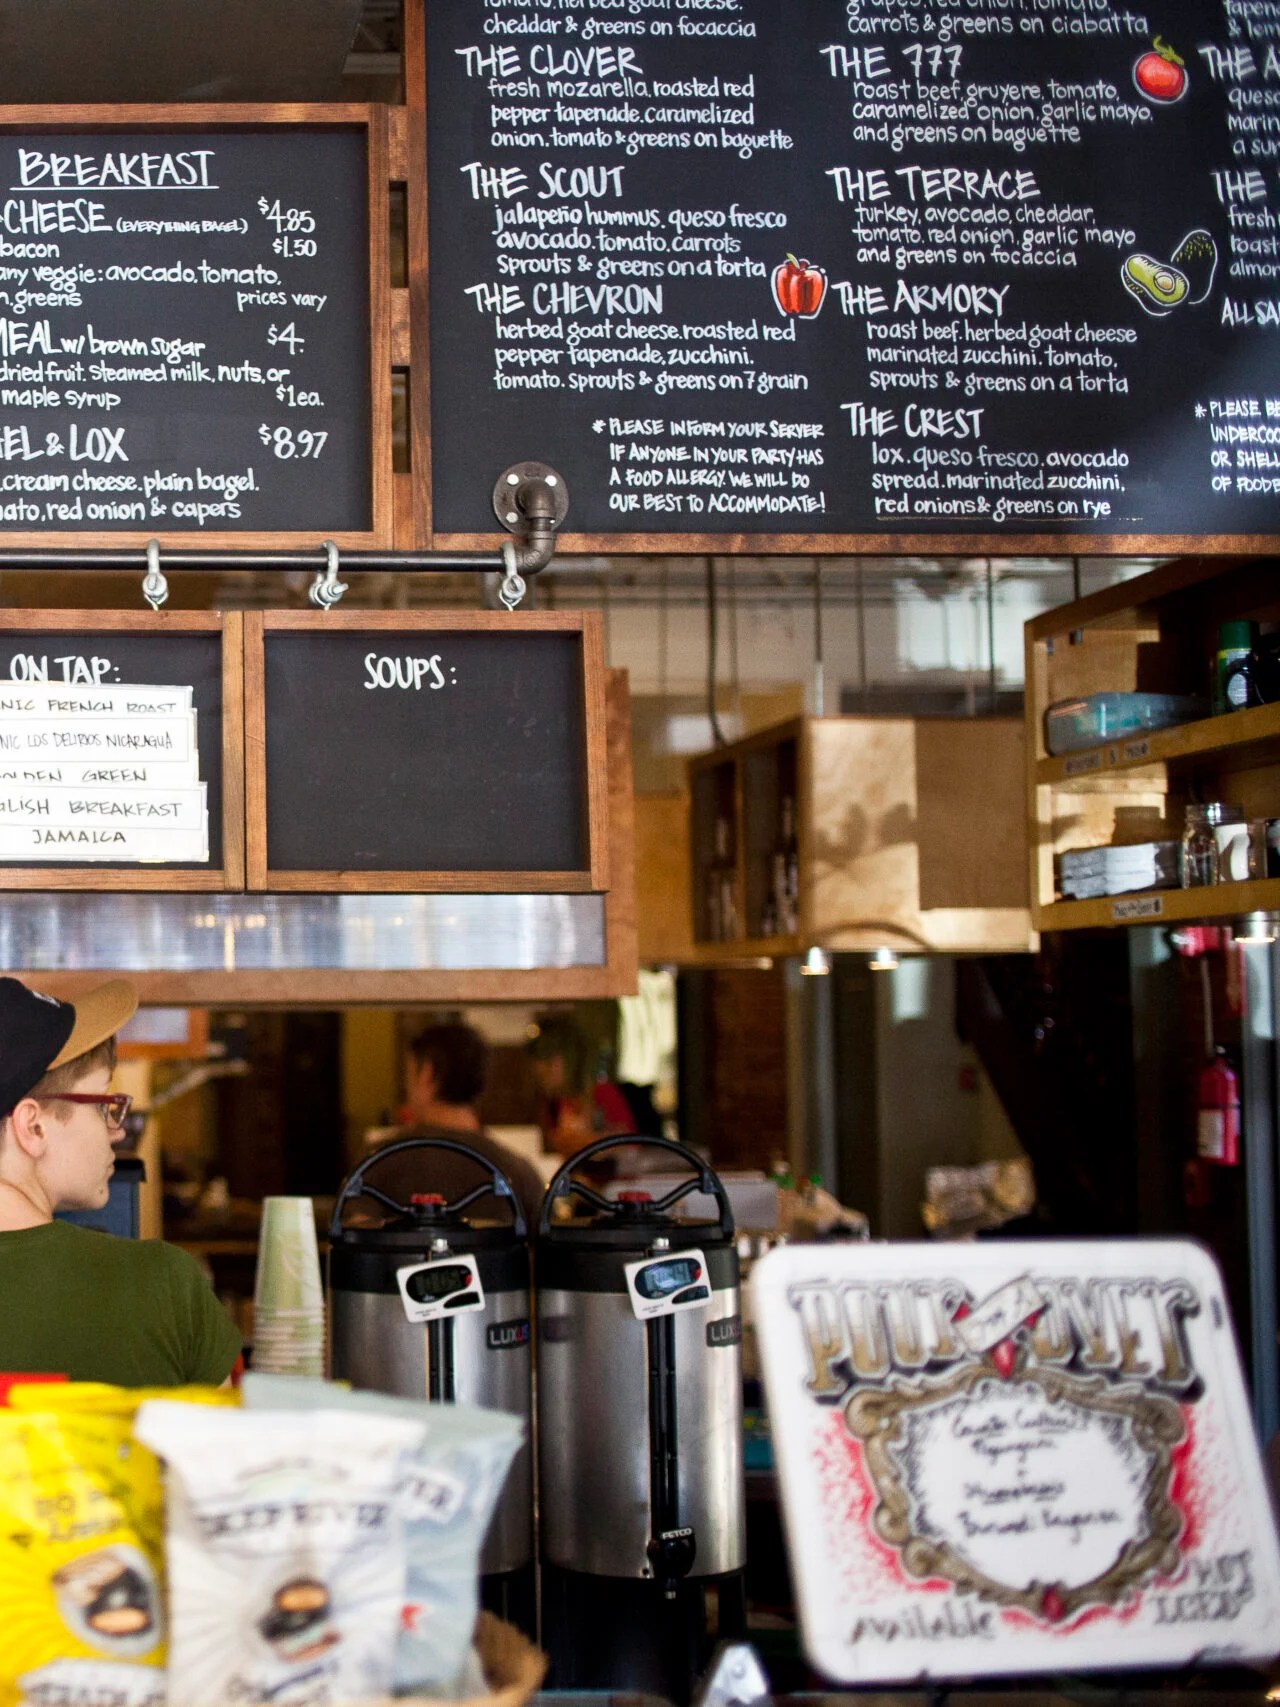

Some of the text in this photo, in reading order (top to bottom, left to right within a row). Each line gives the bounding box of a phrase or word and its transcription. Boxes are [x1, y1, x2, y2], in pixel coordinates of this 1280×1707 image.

[484, 13, 756, 40] cheddar & greens on focaccia
[455, 44, 643, 77] THE CLOVER
[819, 43, 962, 79] THE 777
[1198, 46, 1256, 81] THE
[853, 122, 1081, 152] and greens on baguette
[18, 148, 216, 187] BREAKFAST
[460, 162, 625, 199] THE SCOUT
[825, 166, 1040, 201] THE TERRACE
[4, 198, 114, 234] CHEESE
[0, 234, 59, 258] bacon
[896, 244, 1077, 270] greens focaccia
[237, 290, 327, 312] prices vary
[464, 281, 662, 315] THE CHEVRON
[831, 279, 1009, 316] THE ARMORY
[87, 324, 148, 356] brown
[151, 337, 205, 364] sugar
[870, 368, 1128, 396] sprouts & greens on torta
[2, 386, 61, 408] maple
[64, 390, 121, 410] syrup
[1210, 400, 1261, 418] PLEASE
[609, 418, 824, 439] PLEASE INFORM YOUR SERVER
[840, 402, 984, 438] THE CREST
[46, 433, 64, 456] &
[70, 424, 129, 463] LOX
[610, 442, 824, 467] IF ANYONE IN YOUR PARTY HAS
[87, 496, 241, 525] onion & capers
[610, 493, 640, 512] OUR
[643, 493, 683, 512] BEST
[10, 653, 49, 682] ON
[364, 652, 456, 690] SOUPS:
[48, 699, 114, 713] FRENCH
[27, 732, 49, 748] LOS
[106, 730, 174, 749] NICARAGUA
[82, 769, 147, 782] GREEN
[69, 800, 183, 817] BREAKFAST
[33, 829, 126, 844] JAMAICA
